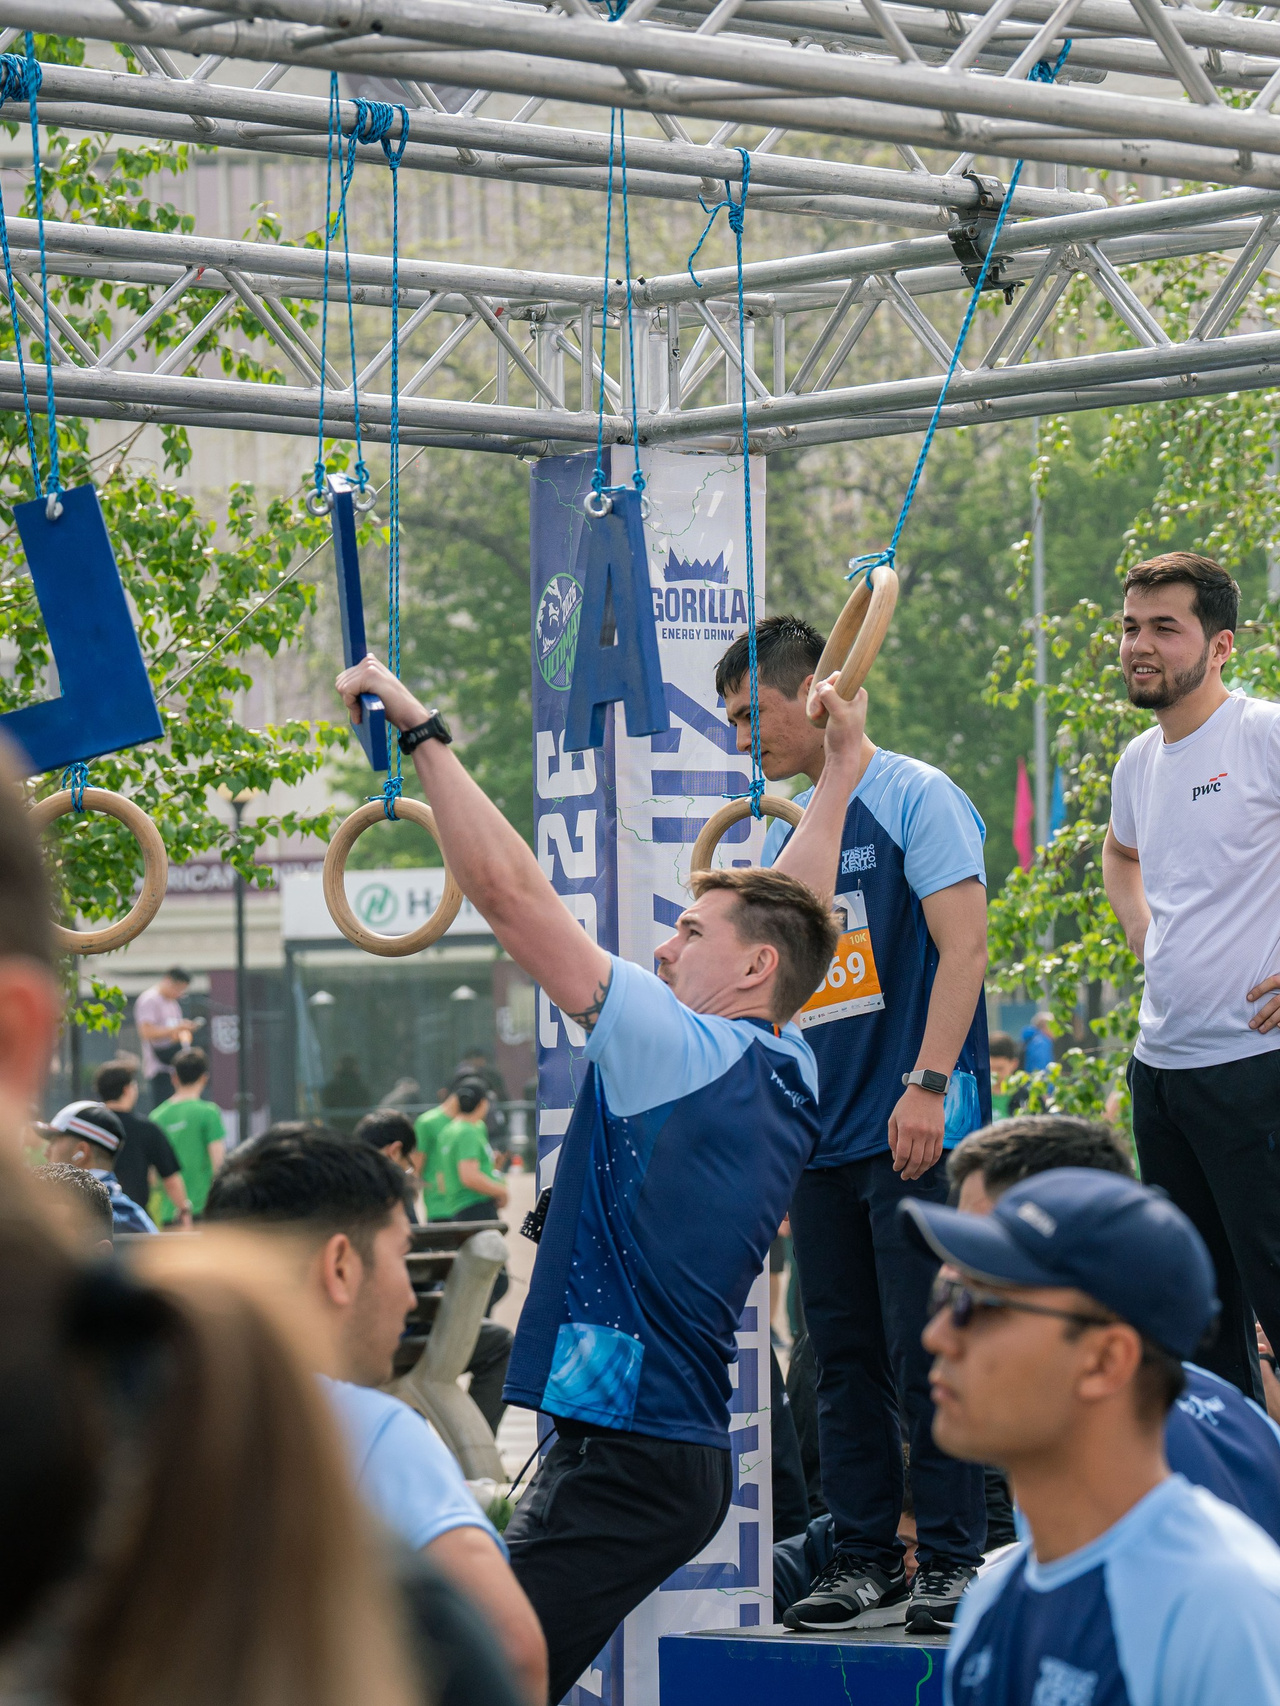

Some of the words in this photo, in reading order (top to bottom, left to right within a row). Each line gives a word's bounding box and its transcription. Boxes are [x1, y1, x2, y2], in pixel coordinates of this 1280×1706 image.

[650, 587, 749, 624] GORILLA
[562, 487, 669, 753] A
[662, 628, 701, 641] ENERGY
[703, 628, 735, 641] DRINK
[1192, 782, 1221, 801] pwc
[842, 848, 869, 862] TASH
[850, 933, 868, 945] 10K
